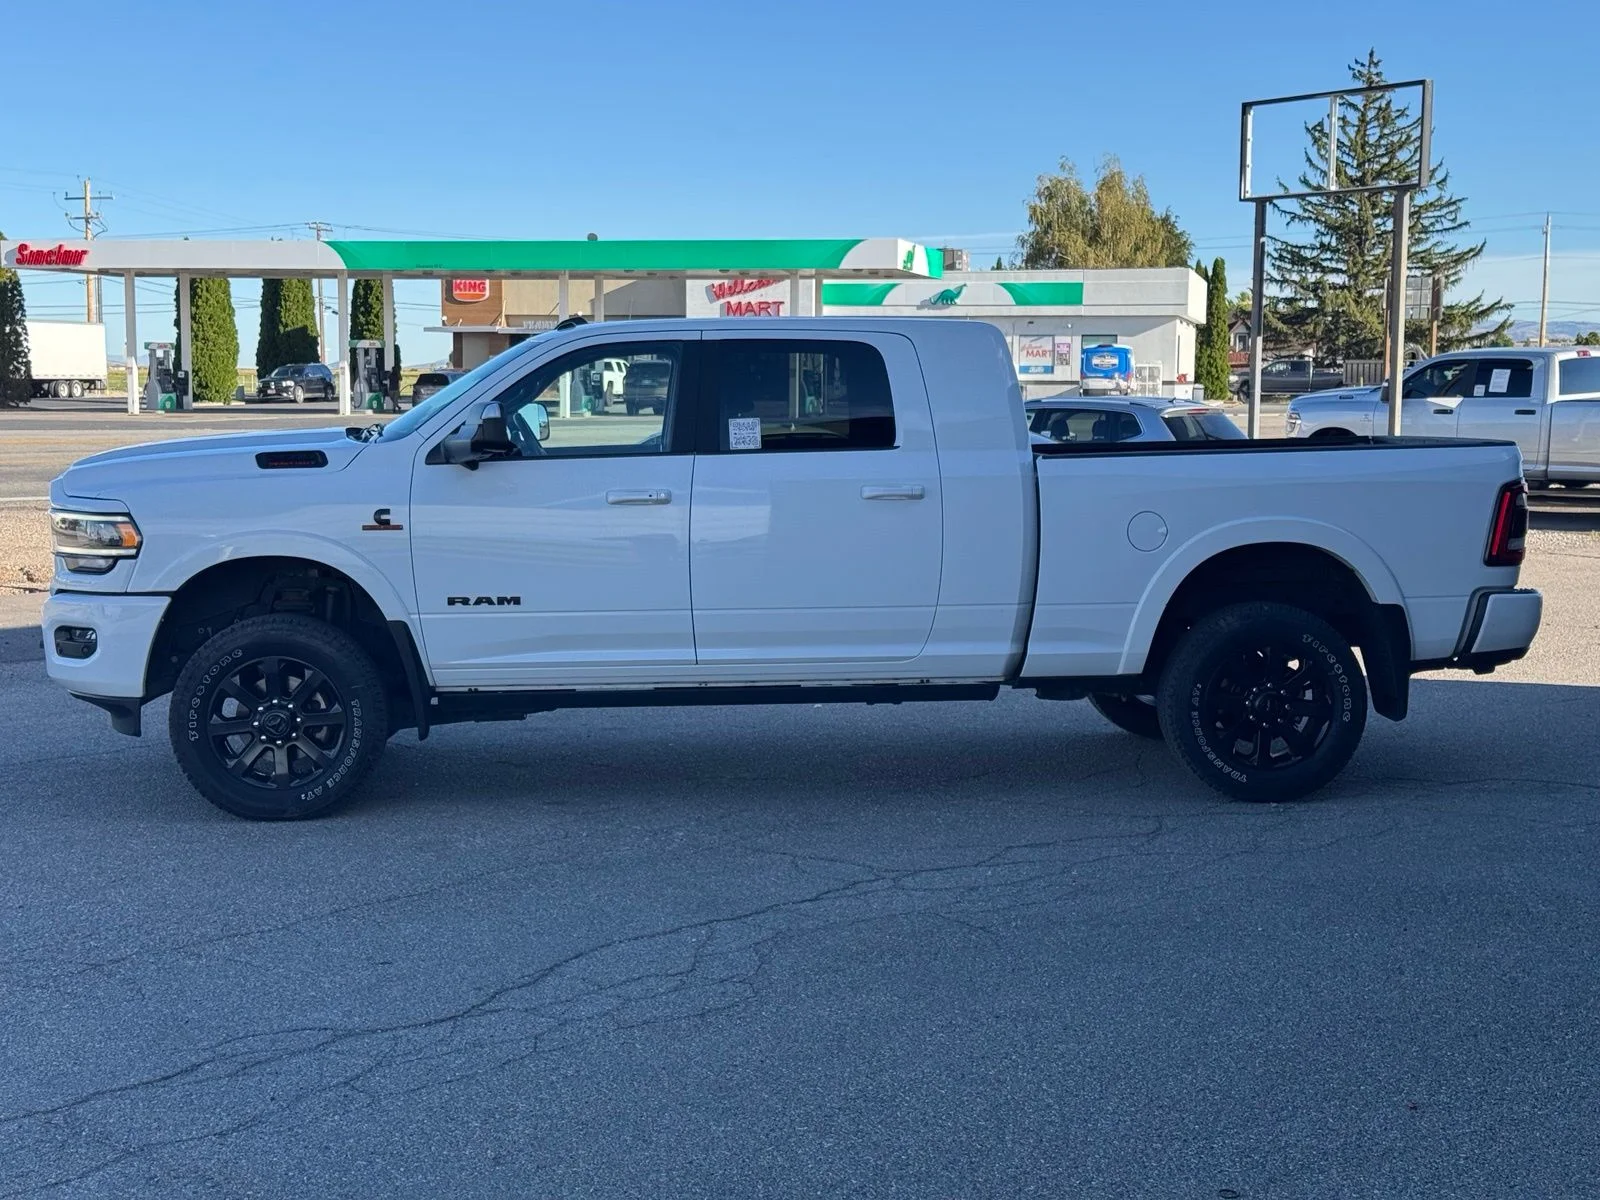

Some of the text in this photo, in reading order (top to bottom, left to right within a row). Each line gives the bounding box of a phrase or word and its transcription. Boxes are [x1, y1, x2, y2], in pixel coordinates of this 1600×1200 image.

[453, 281, 487, 293] KING
[726, 301, 785, 317] MART
[447, 596, 521, 606] RAM
[326, 699, 363, 789] TRANSFORCE
[1191, 711, 1248, 783] TRANSFORCE
